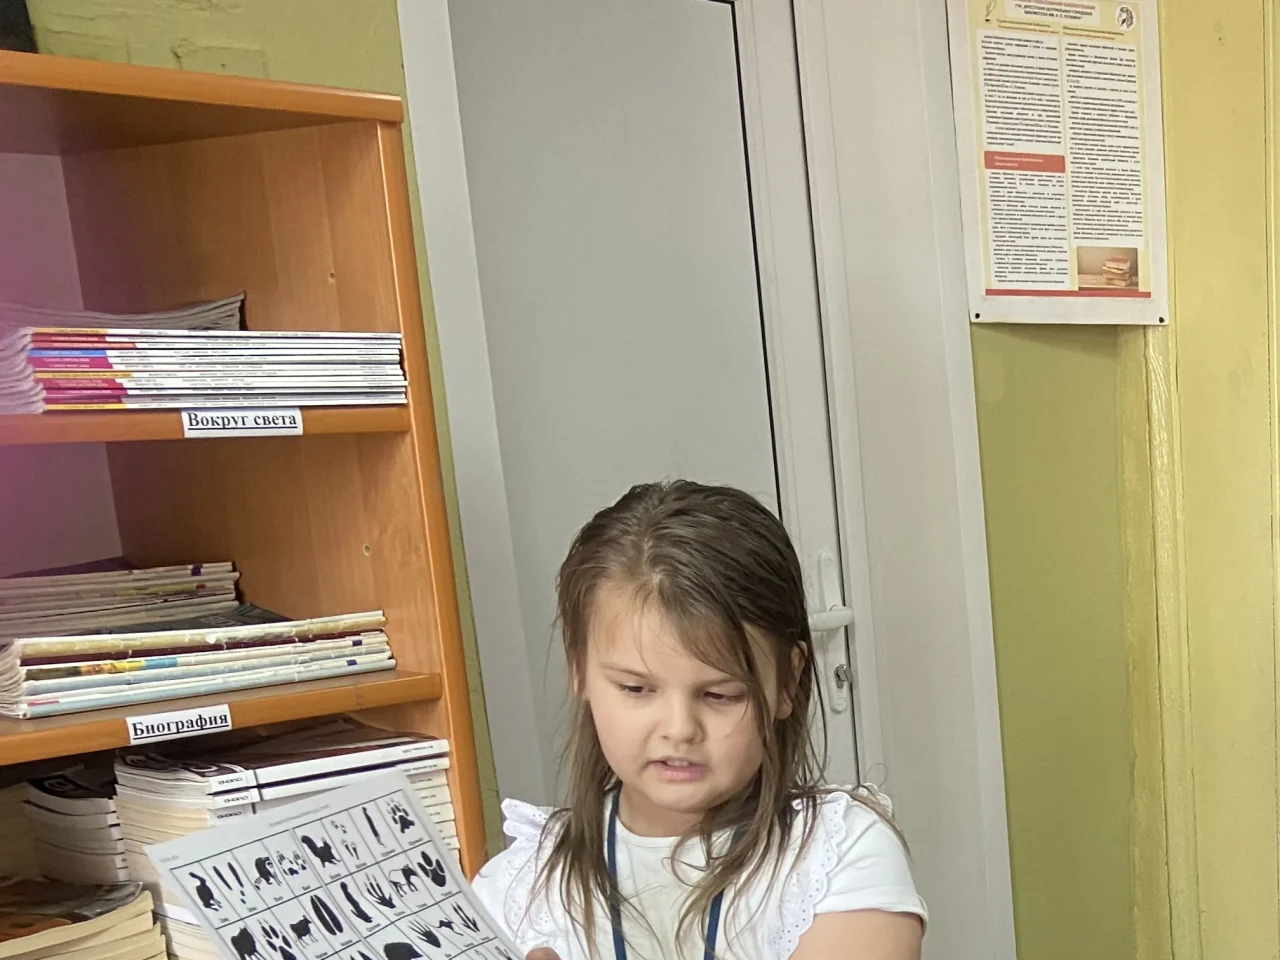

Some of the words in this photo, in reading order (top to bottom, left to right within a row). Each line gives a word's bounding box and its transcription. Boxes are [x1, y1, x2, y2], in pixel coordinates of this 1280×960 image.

[188, 412, 248, 428] Вокруг
[254, 414, 297, 426] света
[131, 713, 228, 737] Биография
